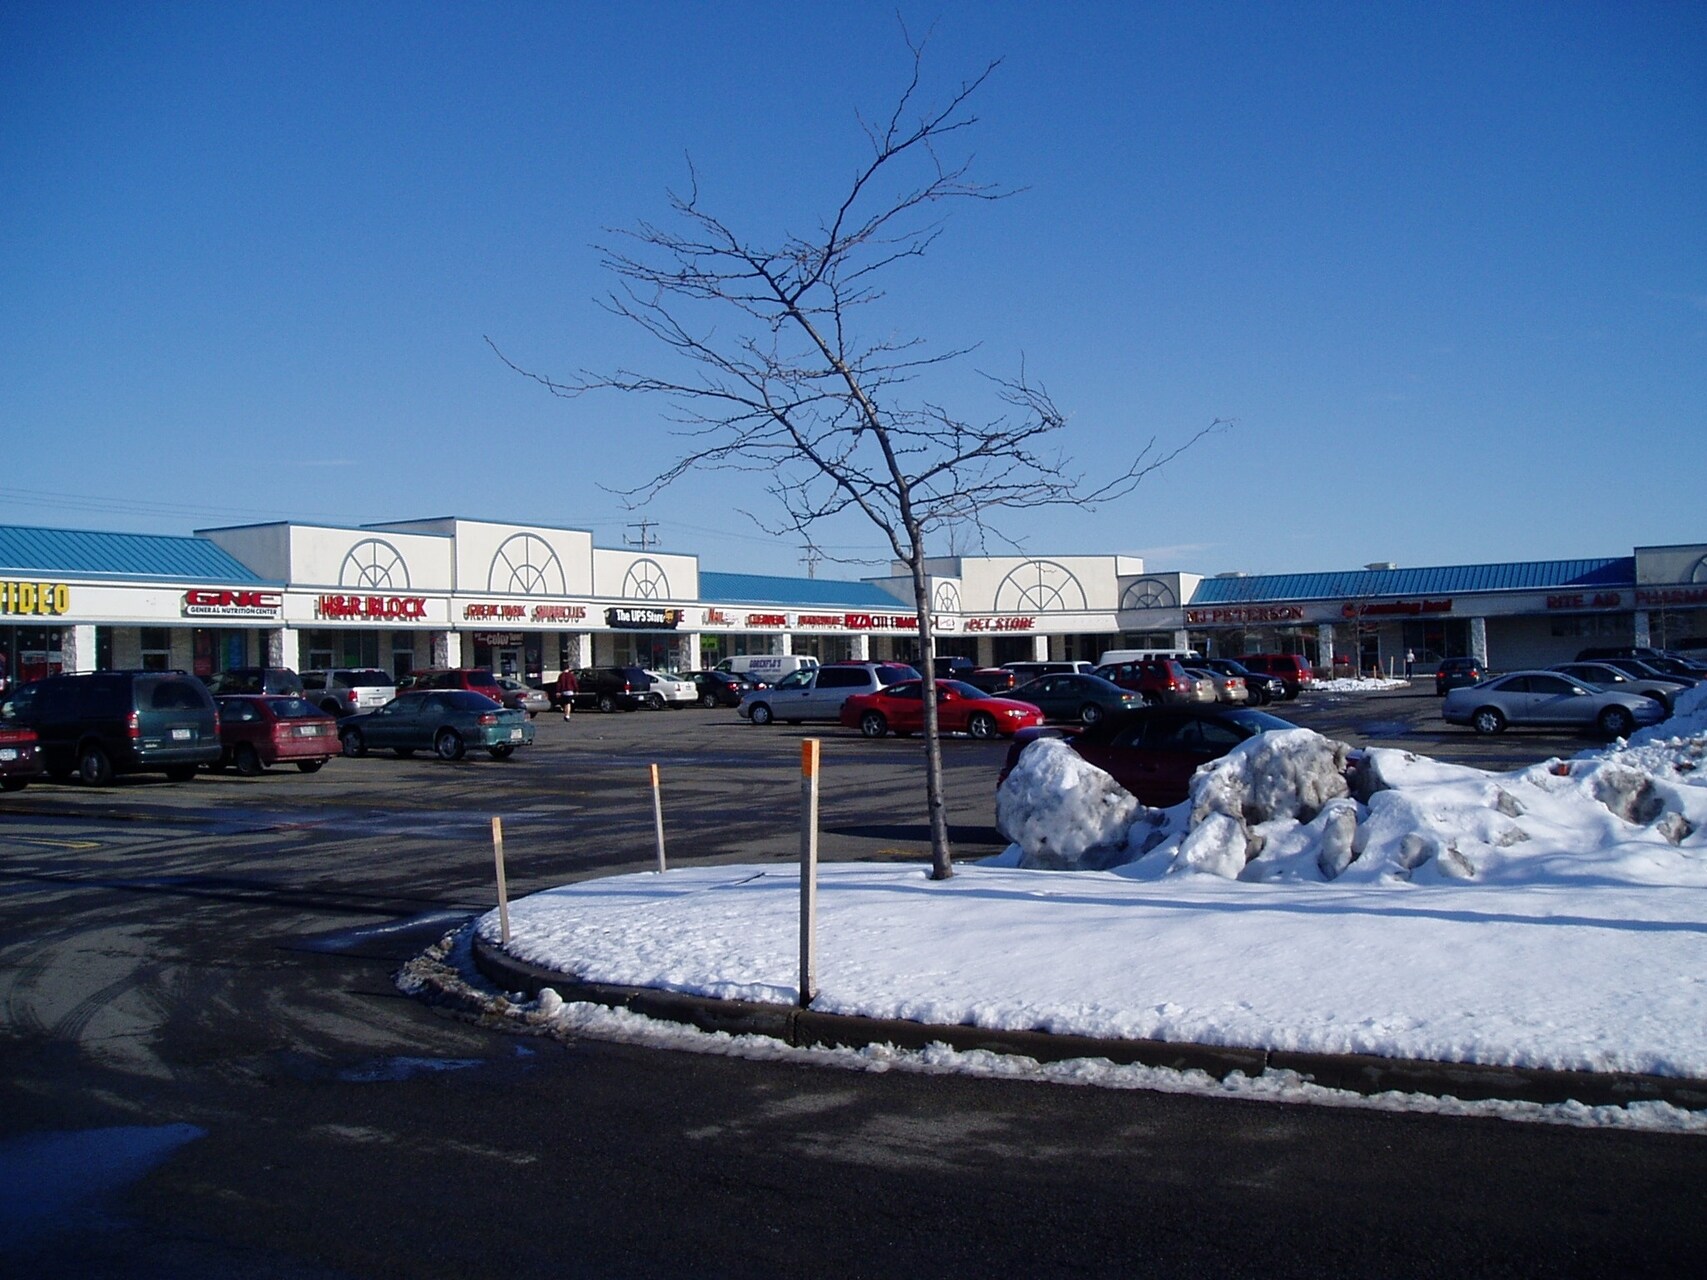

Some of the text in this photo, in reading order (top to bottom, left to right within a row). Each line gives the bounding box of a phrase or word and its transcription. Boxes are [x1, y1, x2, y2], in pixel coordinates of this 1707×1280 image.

[186, 589, 282, 607] GNC
[318, 593, 427, 618] H&R BLOCK
[1547, 591, 1620, 608] RITE AID
[615, 609, 631, 622] The
[630, 609, 646, 623] UPS
[646, 610, 666, 624] Store
[1212, 605, 1304, 623] PETERSON
[968, 616, 1036, 630] PET STORE
